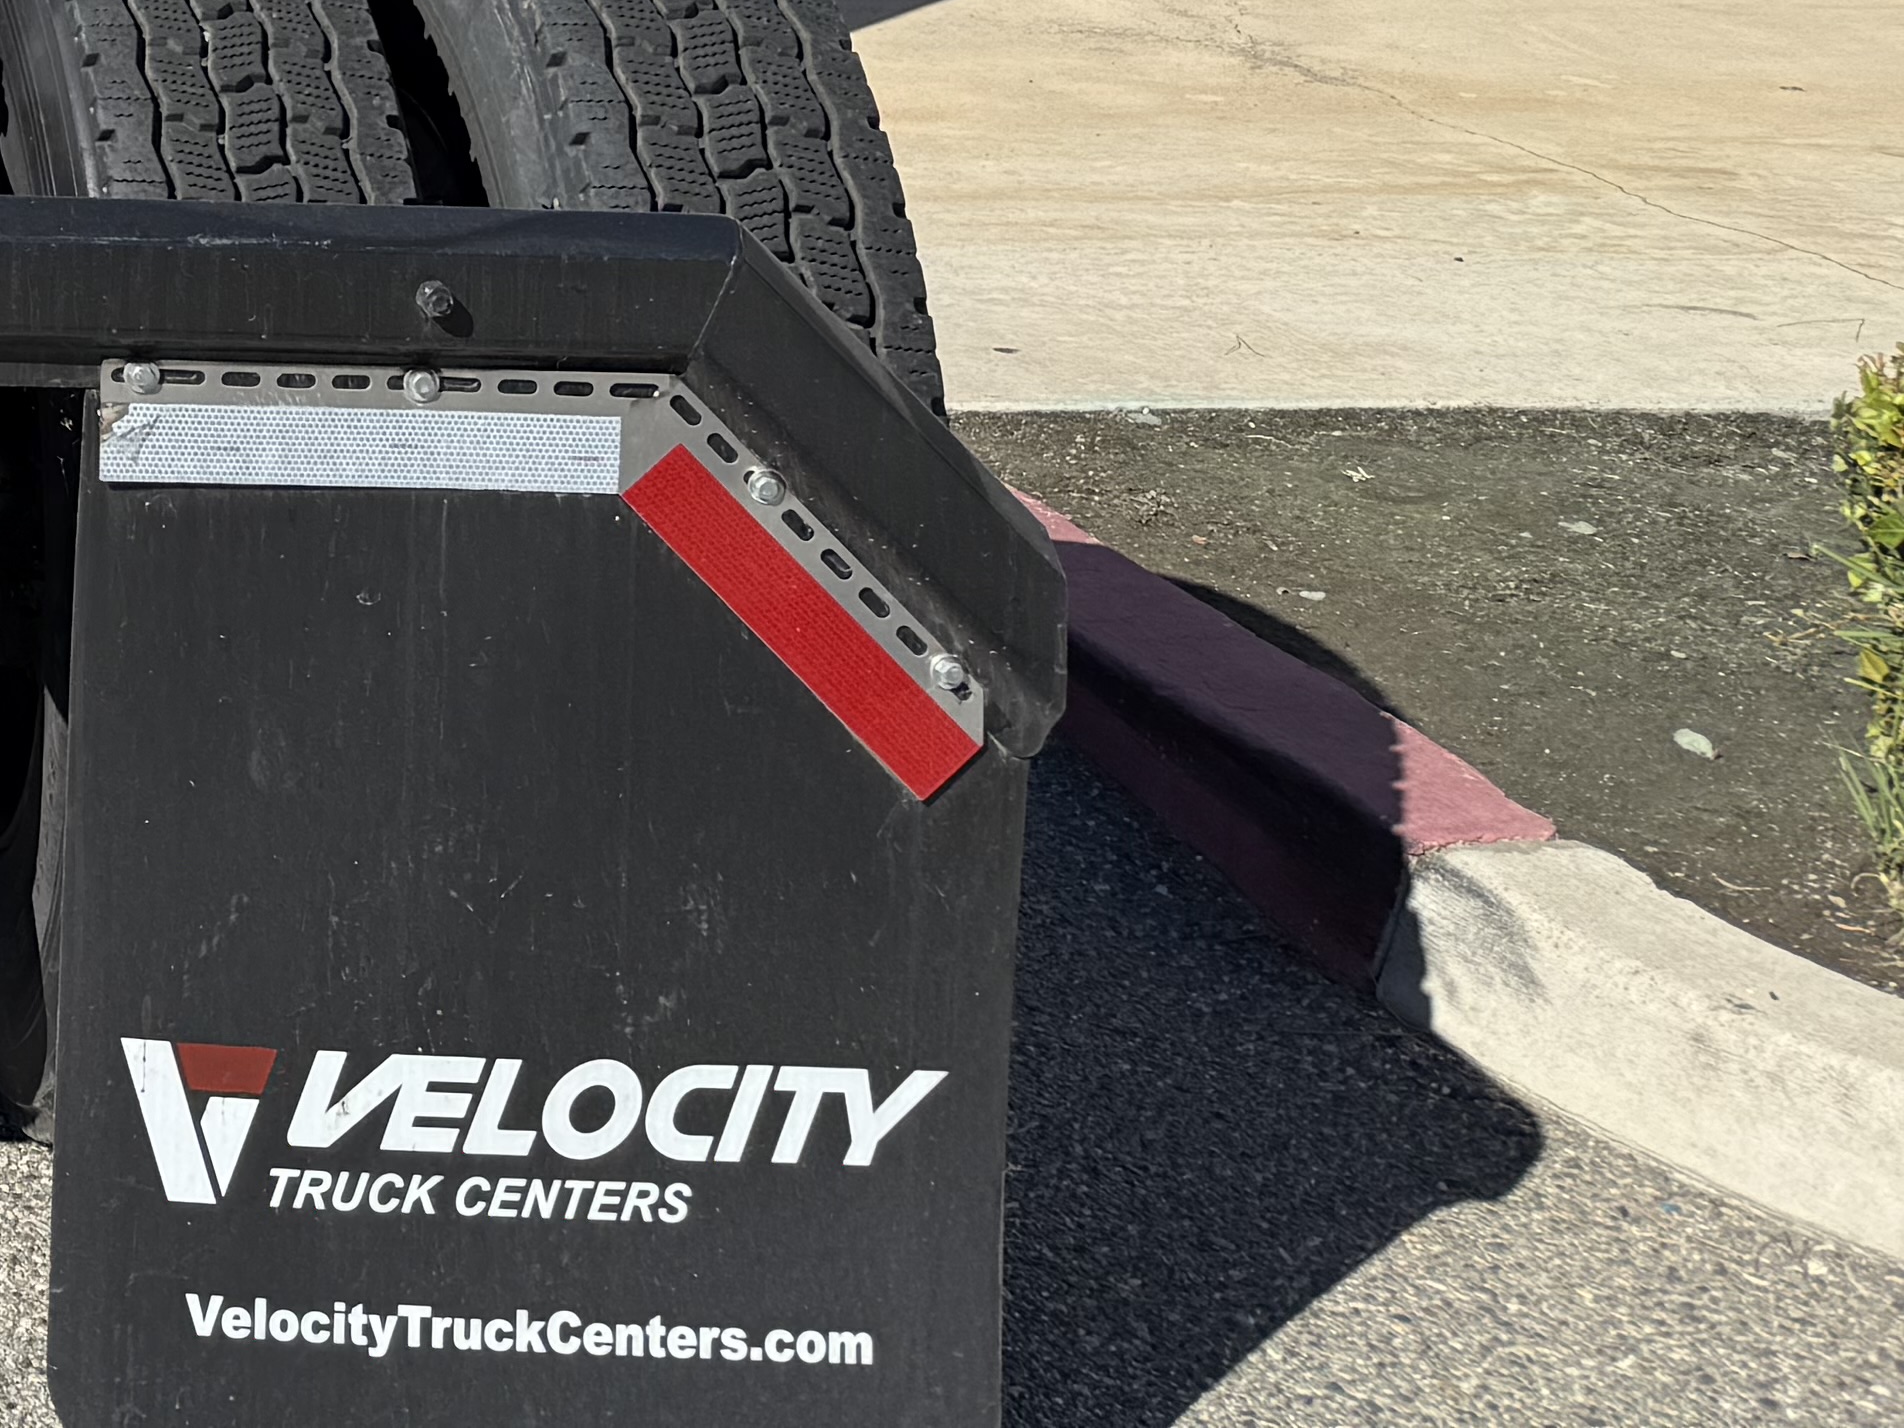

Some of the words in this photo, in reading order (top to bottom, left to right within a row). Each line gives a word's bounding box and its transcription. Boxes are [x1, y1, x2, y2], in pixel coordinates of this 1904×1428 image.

[286, 1049, 949, 1166] VELOCITY
[270, 1168, 444, 1215] TRUCK
[456, 1176, 693, 1223] CENTERS
[185, 1293, 874, 1366] VelocityTruckCenters.com
